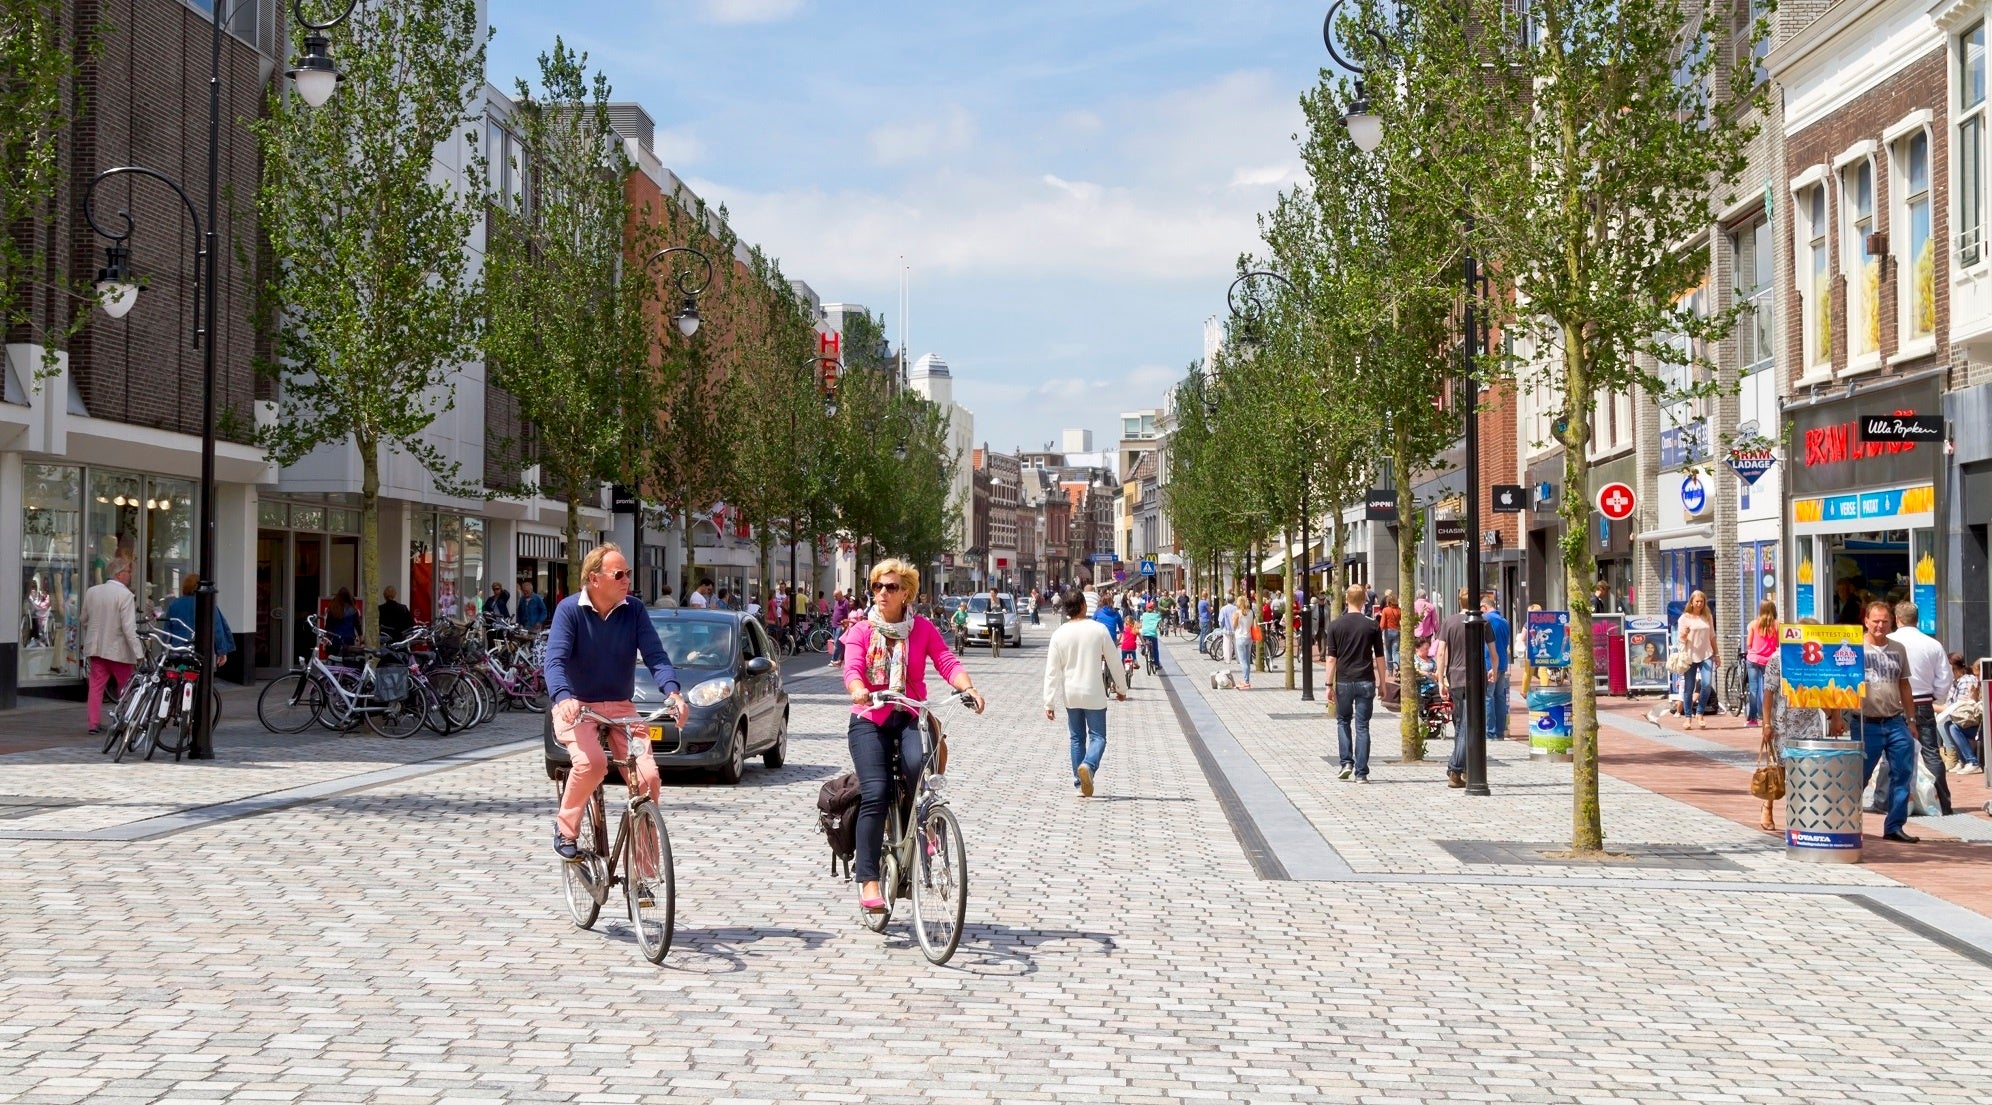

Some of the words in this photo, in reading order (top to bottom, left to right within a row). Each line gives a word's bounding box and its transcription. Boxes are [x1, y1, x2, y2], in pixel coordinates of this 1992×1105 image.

[1868, 420, 1892, 434] Ulla
[1893, 420, 1937, 438] Popken
[1805, 423, 1847, 467] BRAM
[1732, 460, 1771, 469] LADAGE
[1840, 502, 1856, 515] VERSE
[1862, 499, 1879, 514] PATAT
[1802, 641, 1823, 665] 8
